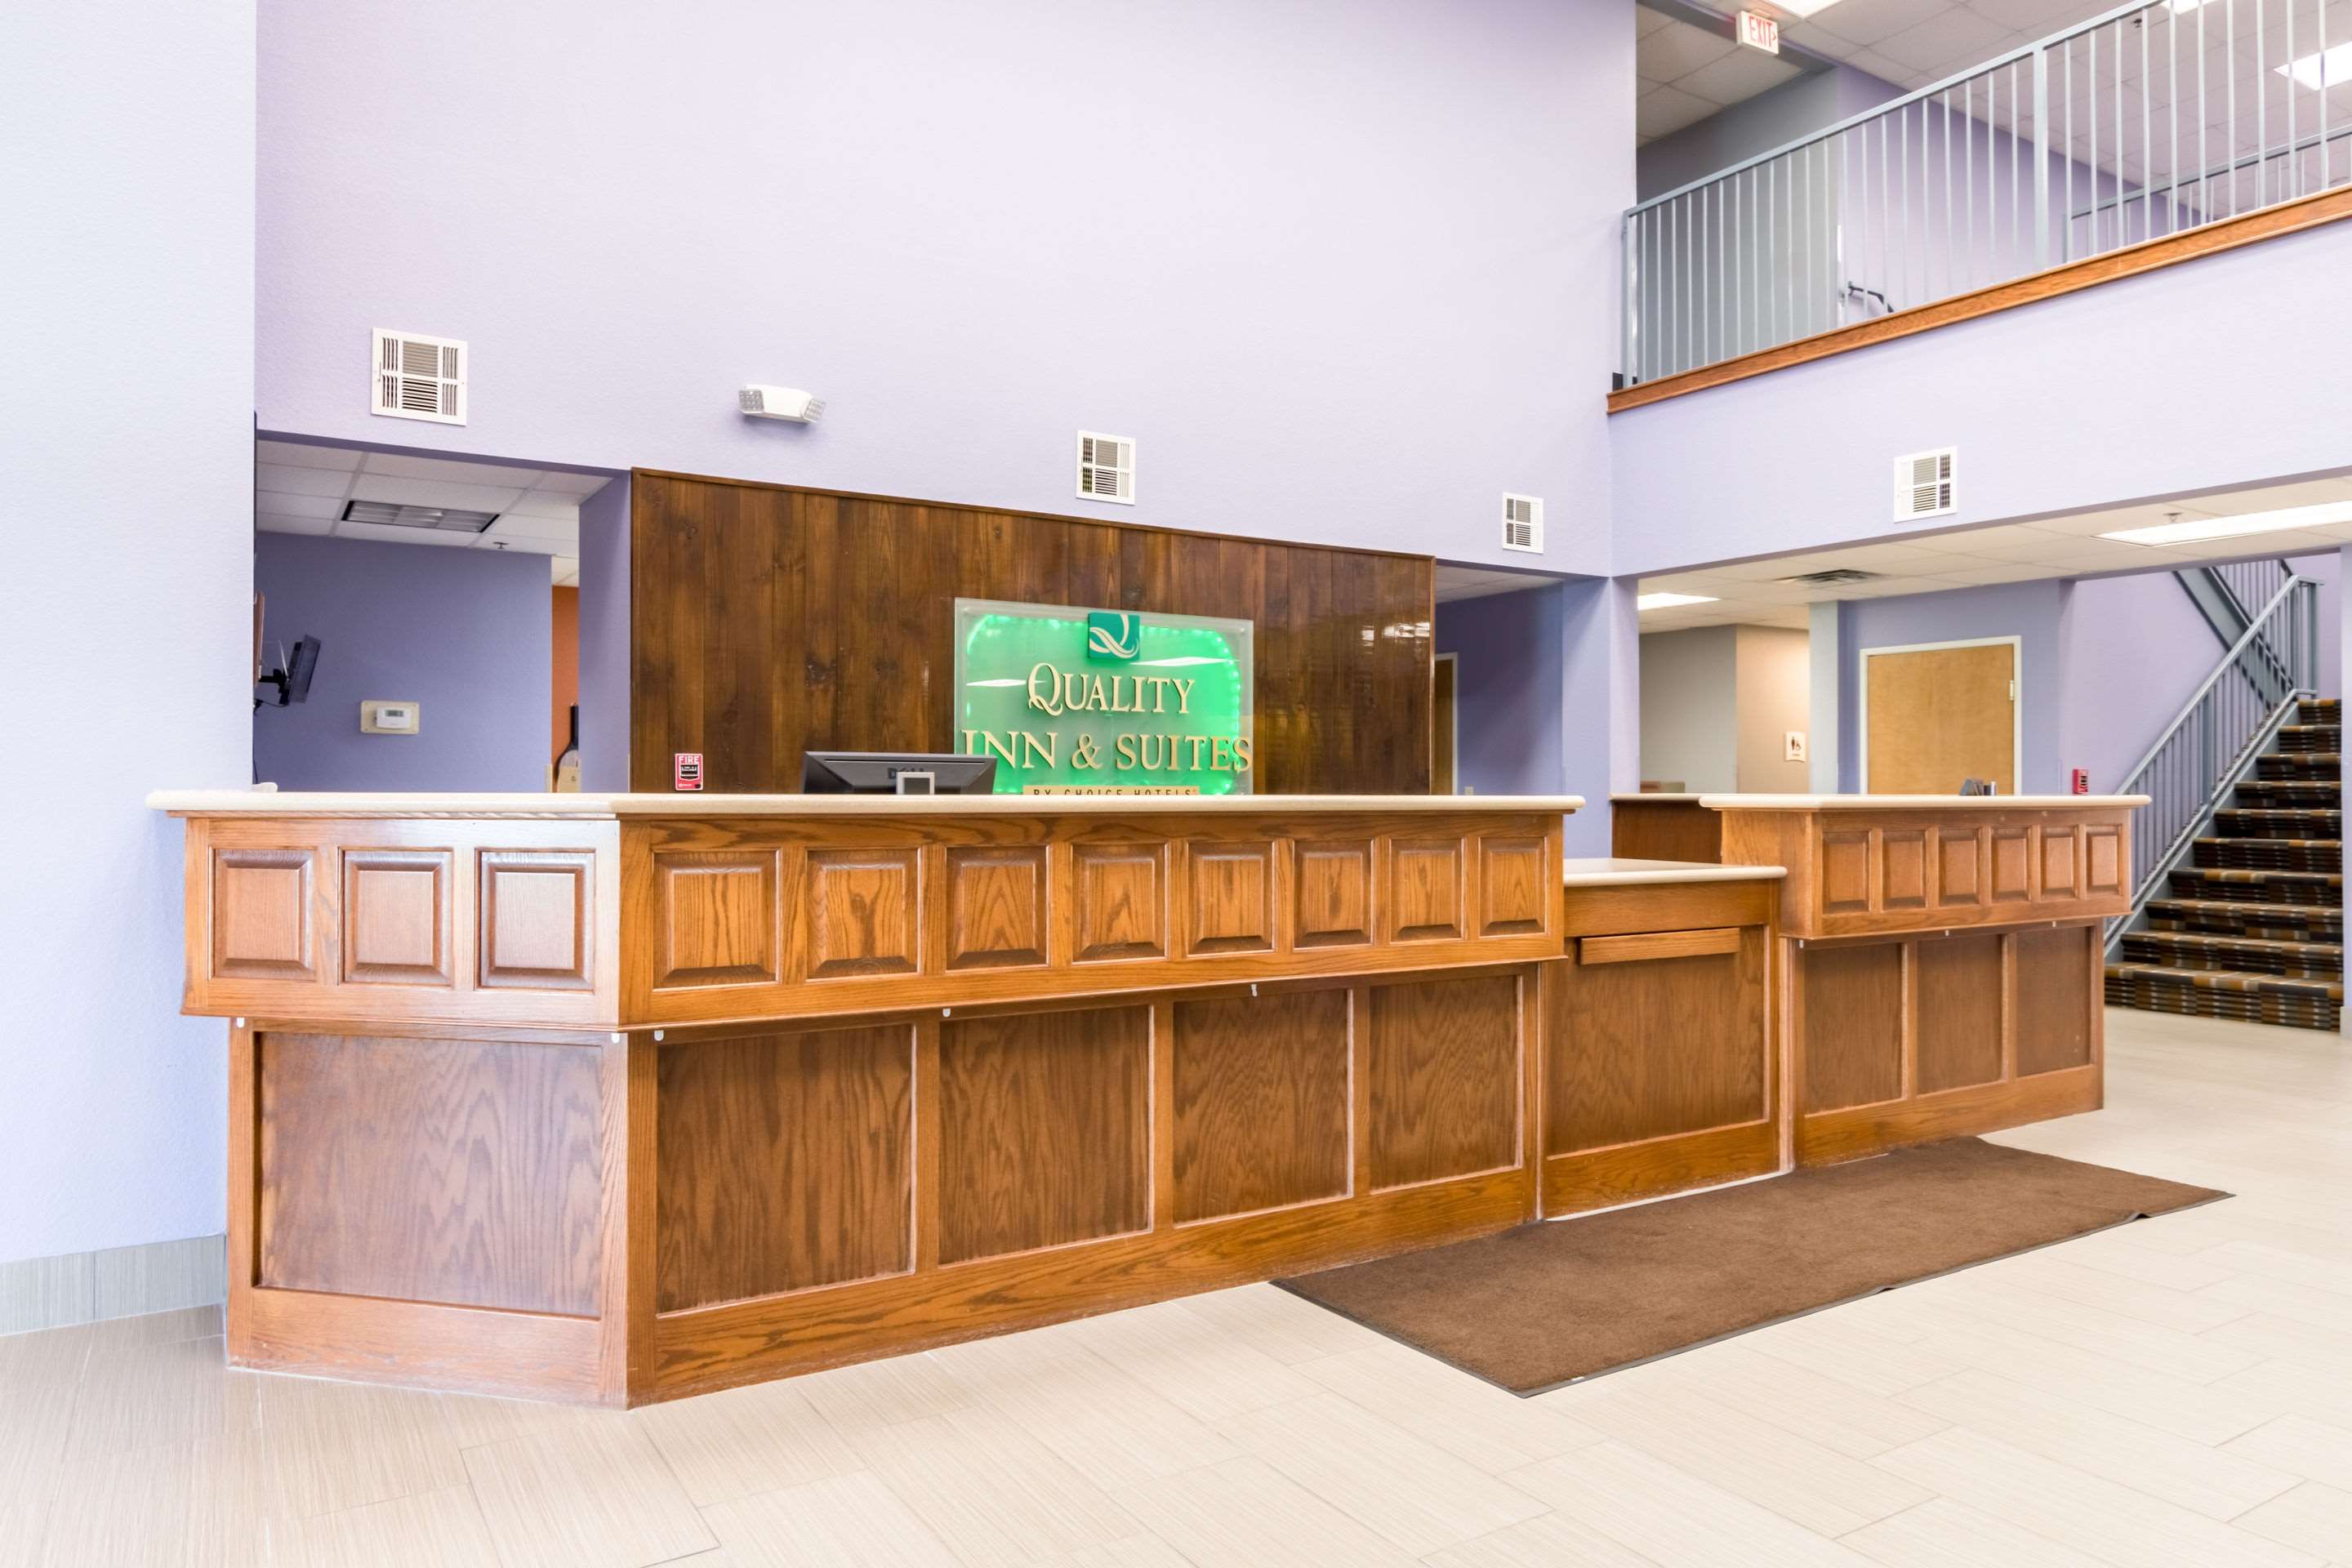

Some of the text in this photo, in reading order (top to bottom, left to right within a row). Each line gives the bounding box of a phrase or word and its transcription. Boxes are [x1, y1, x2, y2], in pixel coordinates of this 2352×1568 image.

[1748, 16, 1772, 47] EXIT
[1027, 662, 1195, 716] QUALITY
[679, 755, 700, 764] FIRE
[961, 729, 1253, 772] INN & SUITES
